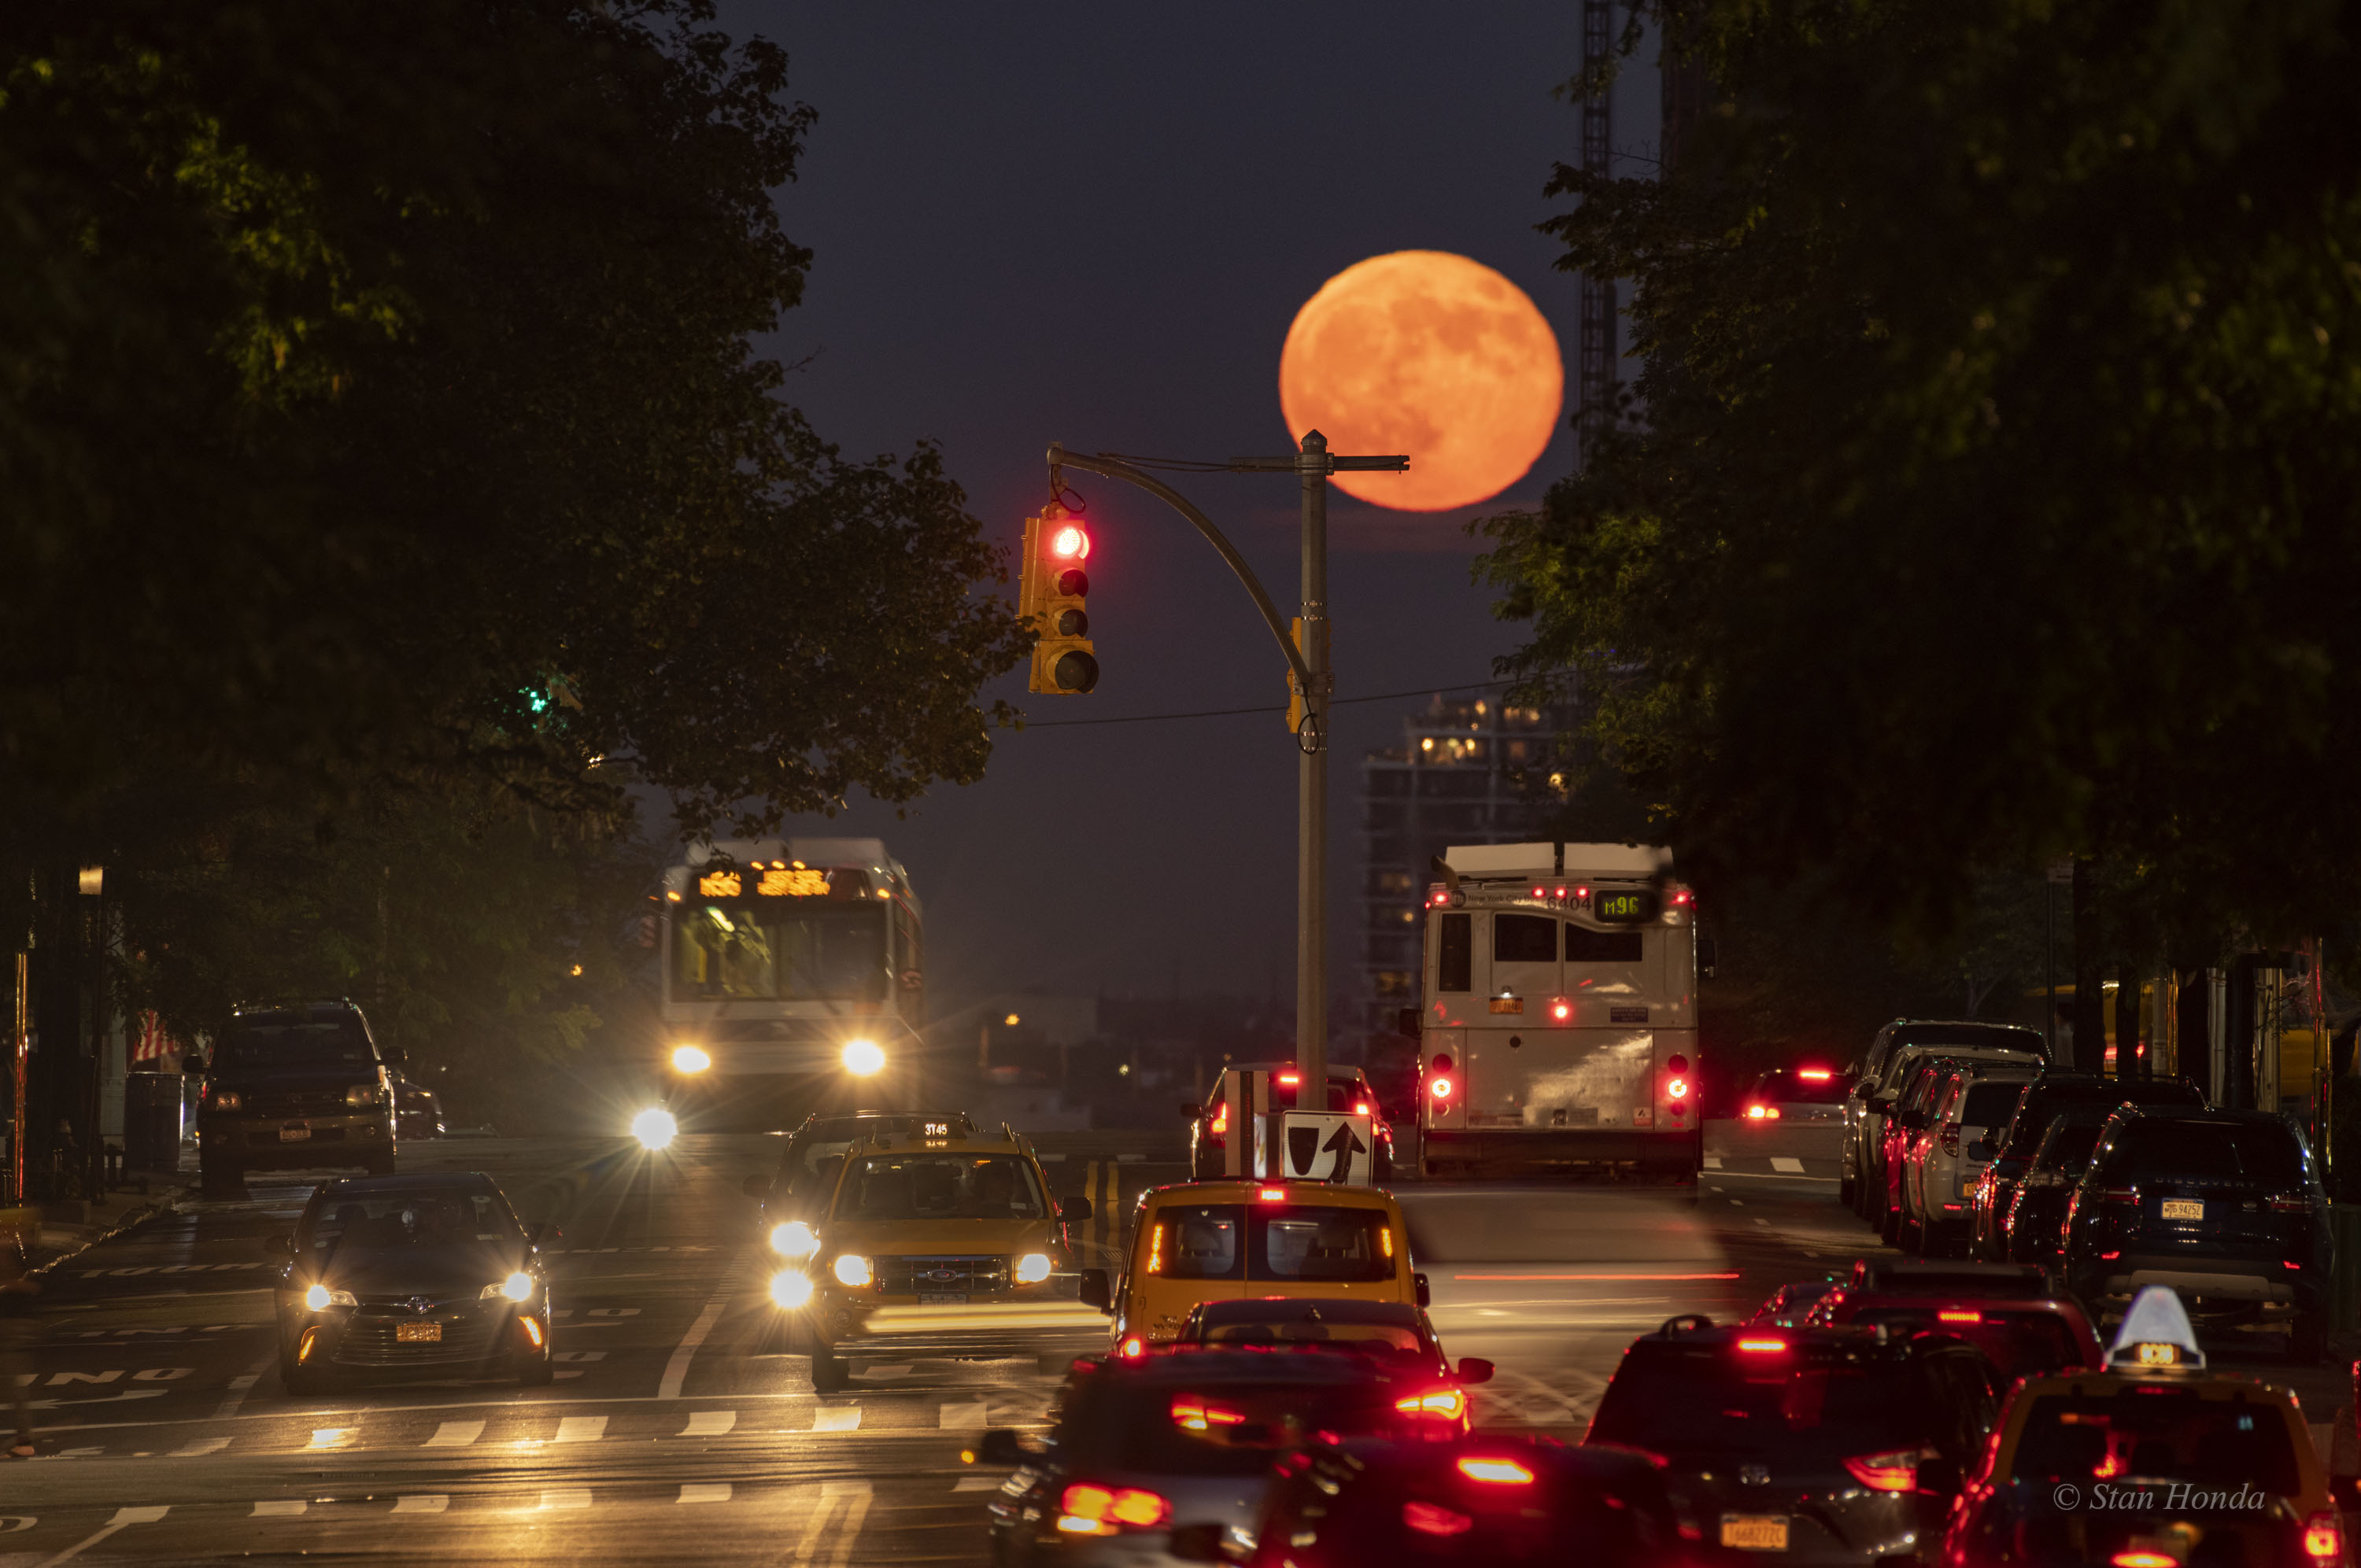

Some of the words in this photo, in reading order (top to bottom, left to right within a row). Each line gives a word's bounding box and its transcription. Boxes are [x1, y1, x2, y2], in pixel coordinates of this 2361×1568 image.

[1506, 895, 1522, 903] City
[1546, 896, 1592, 911] 6404
[1605, 896, 1639, 915] M96
[925, 1123, 948, 1135] 3T45
[2155, 1177, 2256, 1188] DISCOVERY
[2178, 1204, 2201, 1216] 94252
